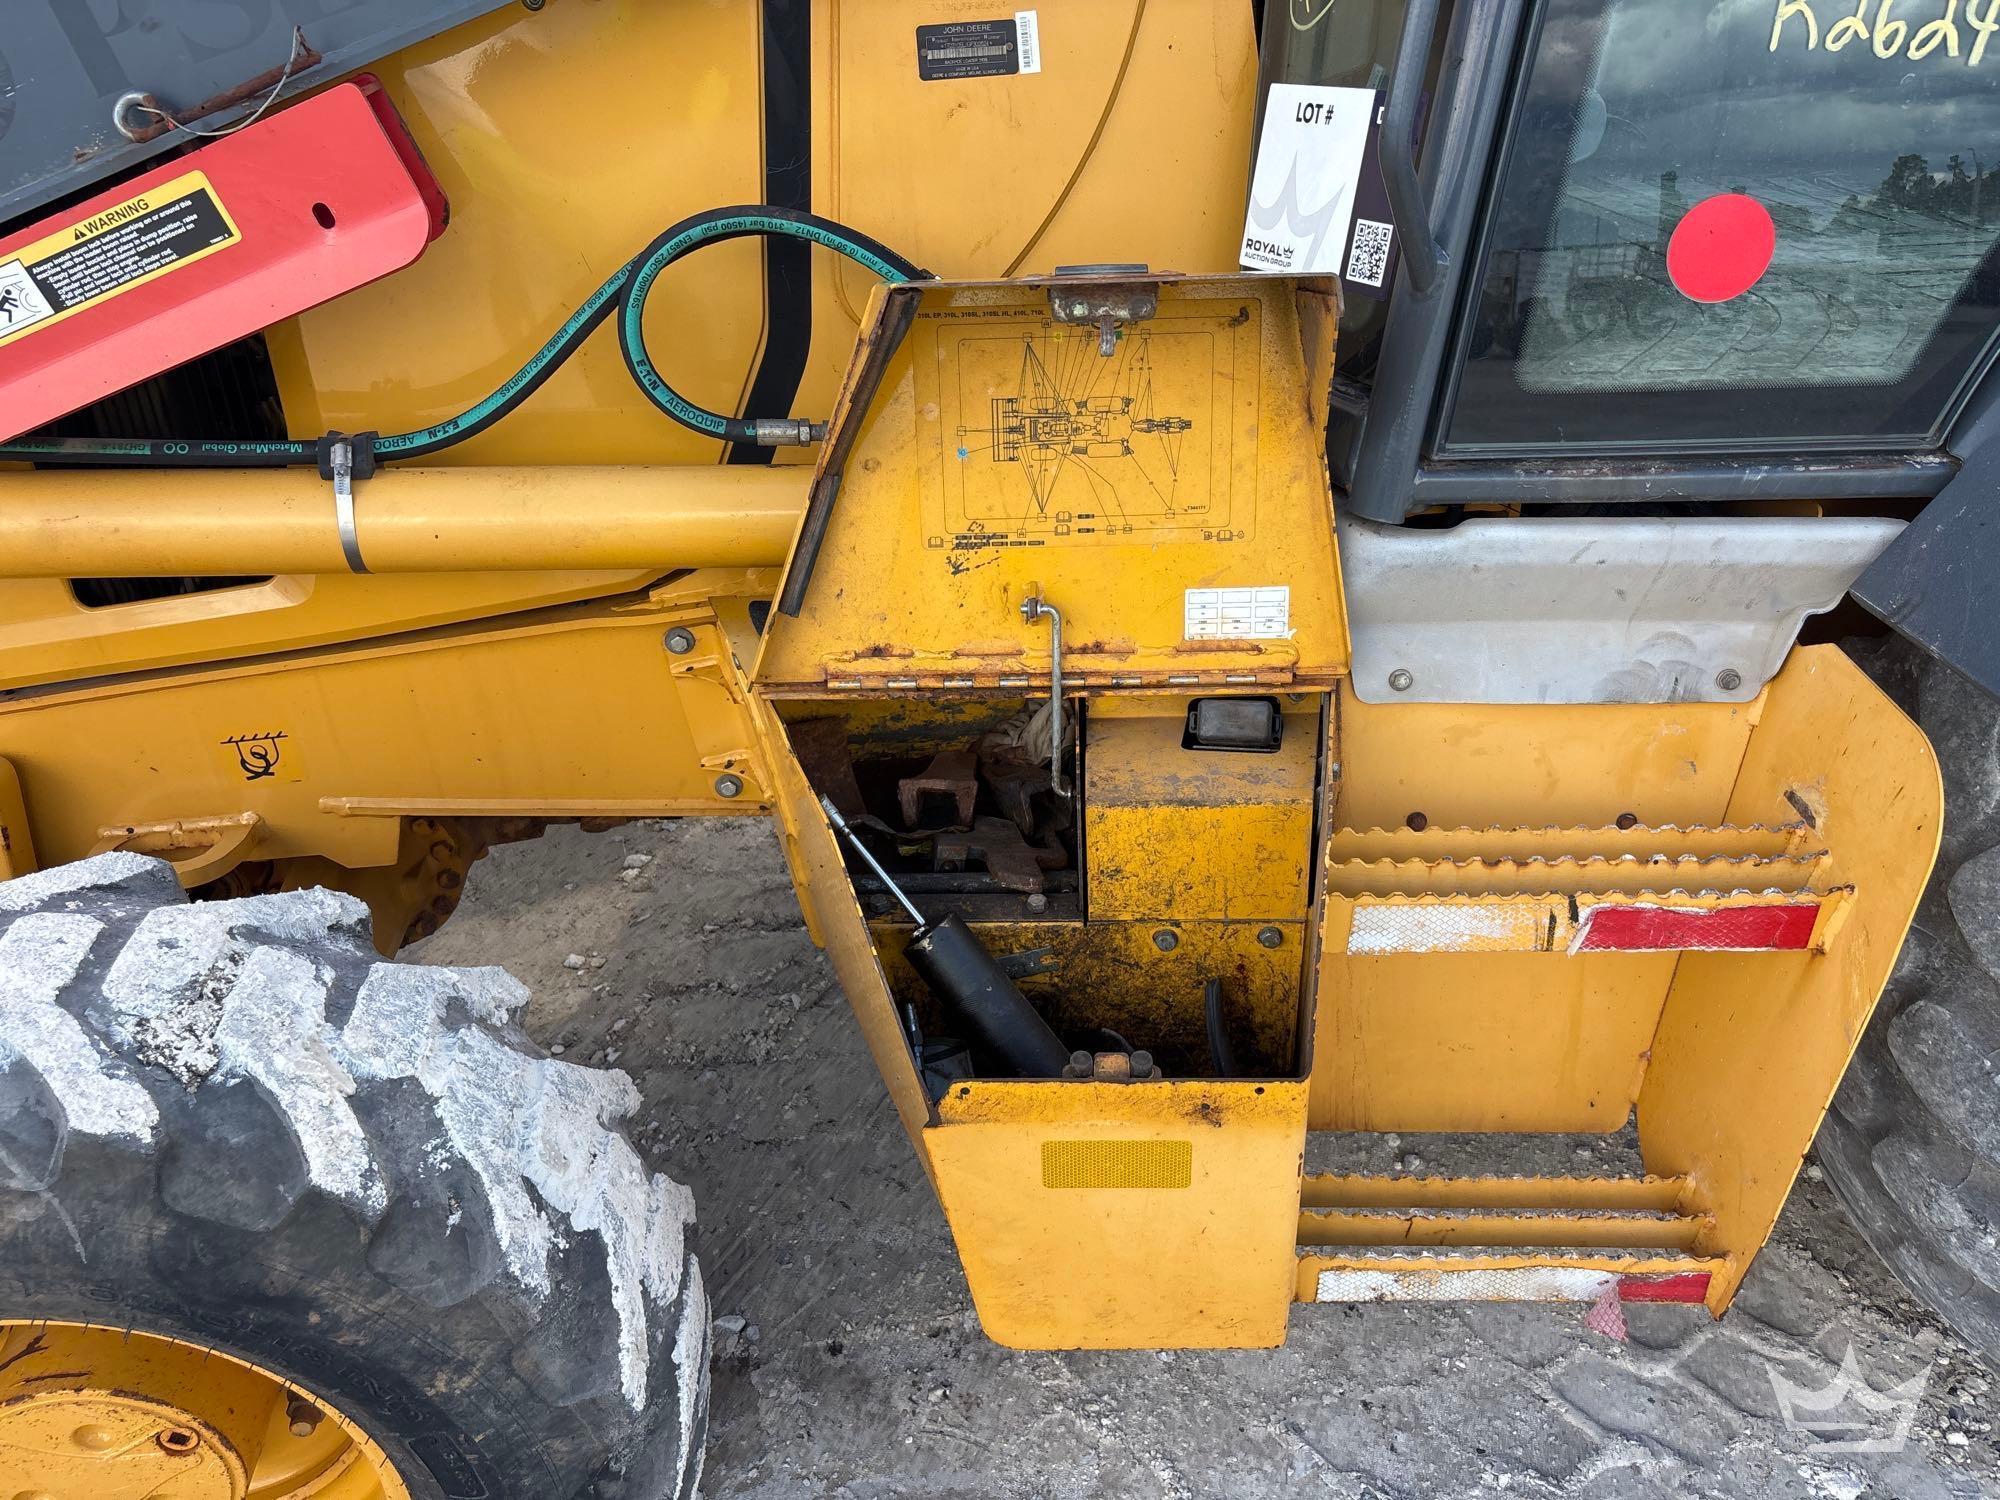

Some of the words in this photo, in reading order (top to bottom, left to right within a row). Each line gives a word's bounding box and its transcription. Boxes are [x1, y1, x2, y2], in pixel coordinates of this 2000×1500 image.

[943, 26, 964, 34] JOHN
[967, 24, 992, 32] DEERE
[1296, 102, 1323, 124] LOT
[1325, 104, 1334, 125] #
[85, 198, 149, 234] WARNING
[721, 220, 747, 231] (4500
[750, 220, 765, 229] bar
[768, 222, 785, 230] 310
[33, 262, 54, 274] Always
[53, 253, 72, 265] install
[71, 247, 89, 257] boom
[88, 240, 102, 249] lock
[101, 232, 120, 243] before
[120, 222, 144, 237] working
[159, 205, 180, 217] around
[180, 200, 192, 208] this
[701, 224, 719, 236] psi)
[795, 225, 821, 240] DN12
[68, 264, 86, 274] loader
[86, 254, 107, 266] bucket
[118, 243, 134, 253] place
[141, 232, 158, 243] dump
[183, 214, 198, 223] raise
[667, 234, 693, 256] EN857
[1246, 238, 1282, 257] ROYAL
[37, 267, 61, 280] machine
[61, 261, 74, 269] with
[83, 248, 102, 259] loader
[102, 241, 120, 251] boom
[120, 231, 139, 243] raised.
[53, 277, 71, 289] boom
[70, 272, 84, 281] until
[83, 265, 101, 275] boom
[100, 259, 114, 268] lock
[114, 248, 136, 262] channel
[156, 226, 186, 244] positioned
[860, 254, 878, 266] mm
[1245, 252, 1270, 263] AUCTION
[1270, 258, 1291, 268] GROUP
[58, 282, 80, 296] cylinder
[92, 270, 106, 279] then
[106, 265, 120, 274] stop
[120, 256, 141, 267] engine.
[84, 288, 101, 298] lower
[100, 281, 118, 291] boom
[118, 274, 132, 283] until
[131, 269, 144, 277] lock
[144, 262, 161, 272] stops
[160, 253, 179, 264] travel.
[94, 276, 111, 286] lower
[110, 270, 124, 278] lock
[124, 264, 138, 273] onto
[138, 254, 160, 267] cylinder
[161, 248, 173, 257] rod.
[588, 287, 608, 309] (4500
[548, 328, 569, 354] EN857
[665, 397, 724, 430] AEROQUIP
[202, 443, 238, 454] Global
[240, 443, 303, 453] MatchMate
